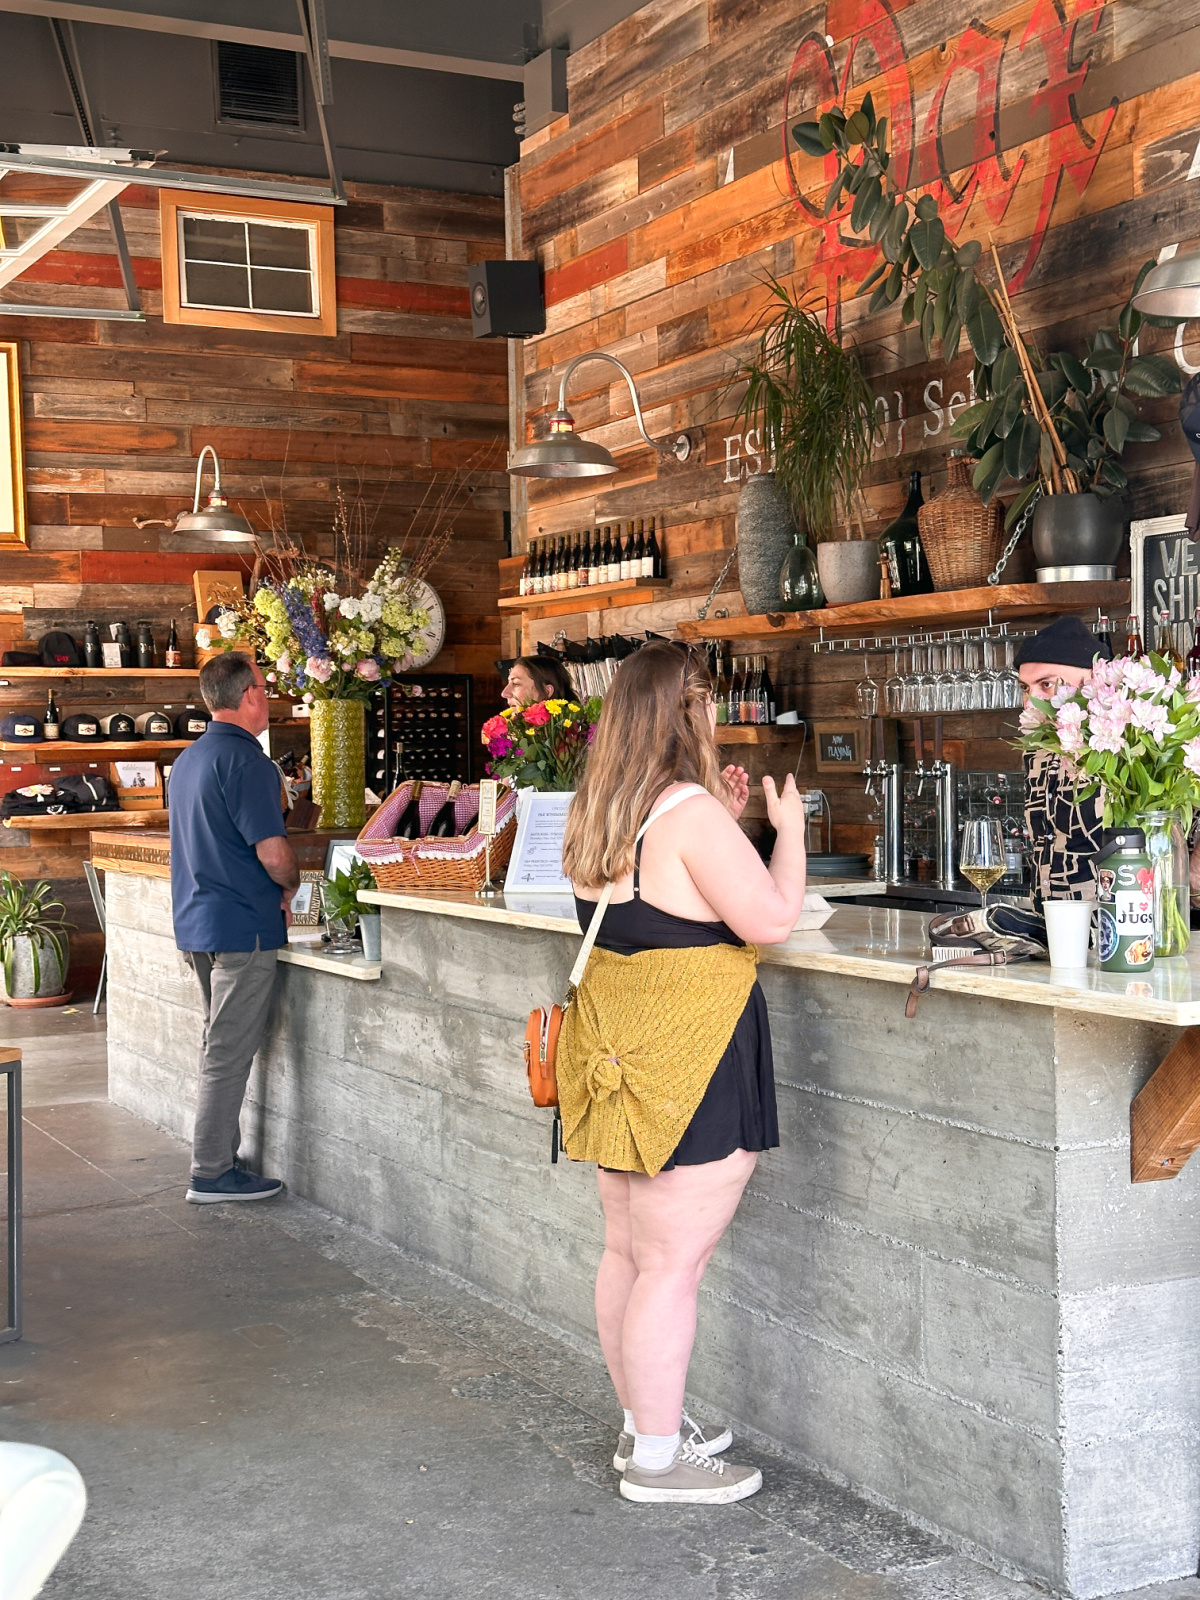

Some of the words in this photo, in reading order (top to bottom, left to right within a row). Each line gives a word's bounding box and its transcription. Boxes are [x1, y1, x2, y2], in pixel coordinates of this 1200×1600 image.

[1159, 537, 1199, 578] WE
[1152, 574, 1200, 624] SHI
[1117, 864, 1137, 886] S
[1118, 910, 1154, 924] JUGS
[1128, 902, 1135, 912] I
